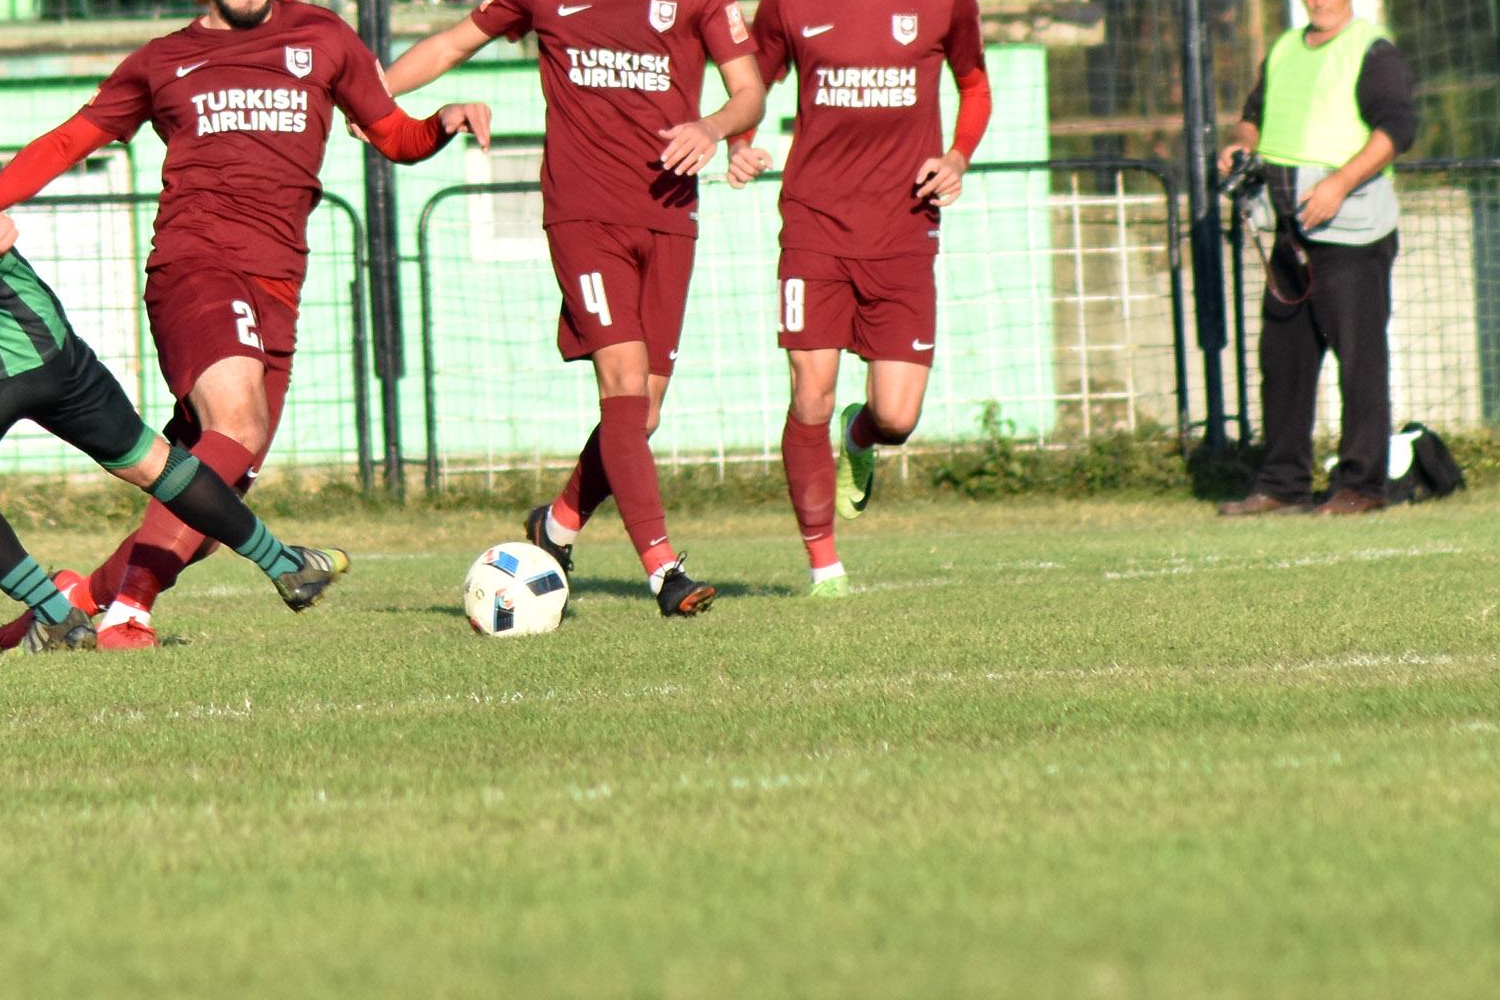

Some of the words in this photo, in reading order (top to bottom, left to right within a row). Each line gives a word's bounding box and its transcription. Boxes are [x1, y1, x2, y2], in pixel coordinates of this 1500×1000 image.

[566, 48, 670, 73] TURKISH
[568, 68, 671, 92] AIRLINES
[816, 67, 917, 88] TURKISH
[191, 88, 308, 114] TURKISH
[815, 87, 917, 107] AIRLINES
[198, 110, 308, 136] AIRLINES
[580, 272, 612, 326] 4
